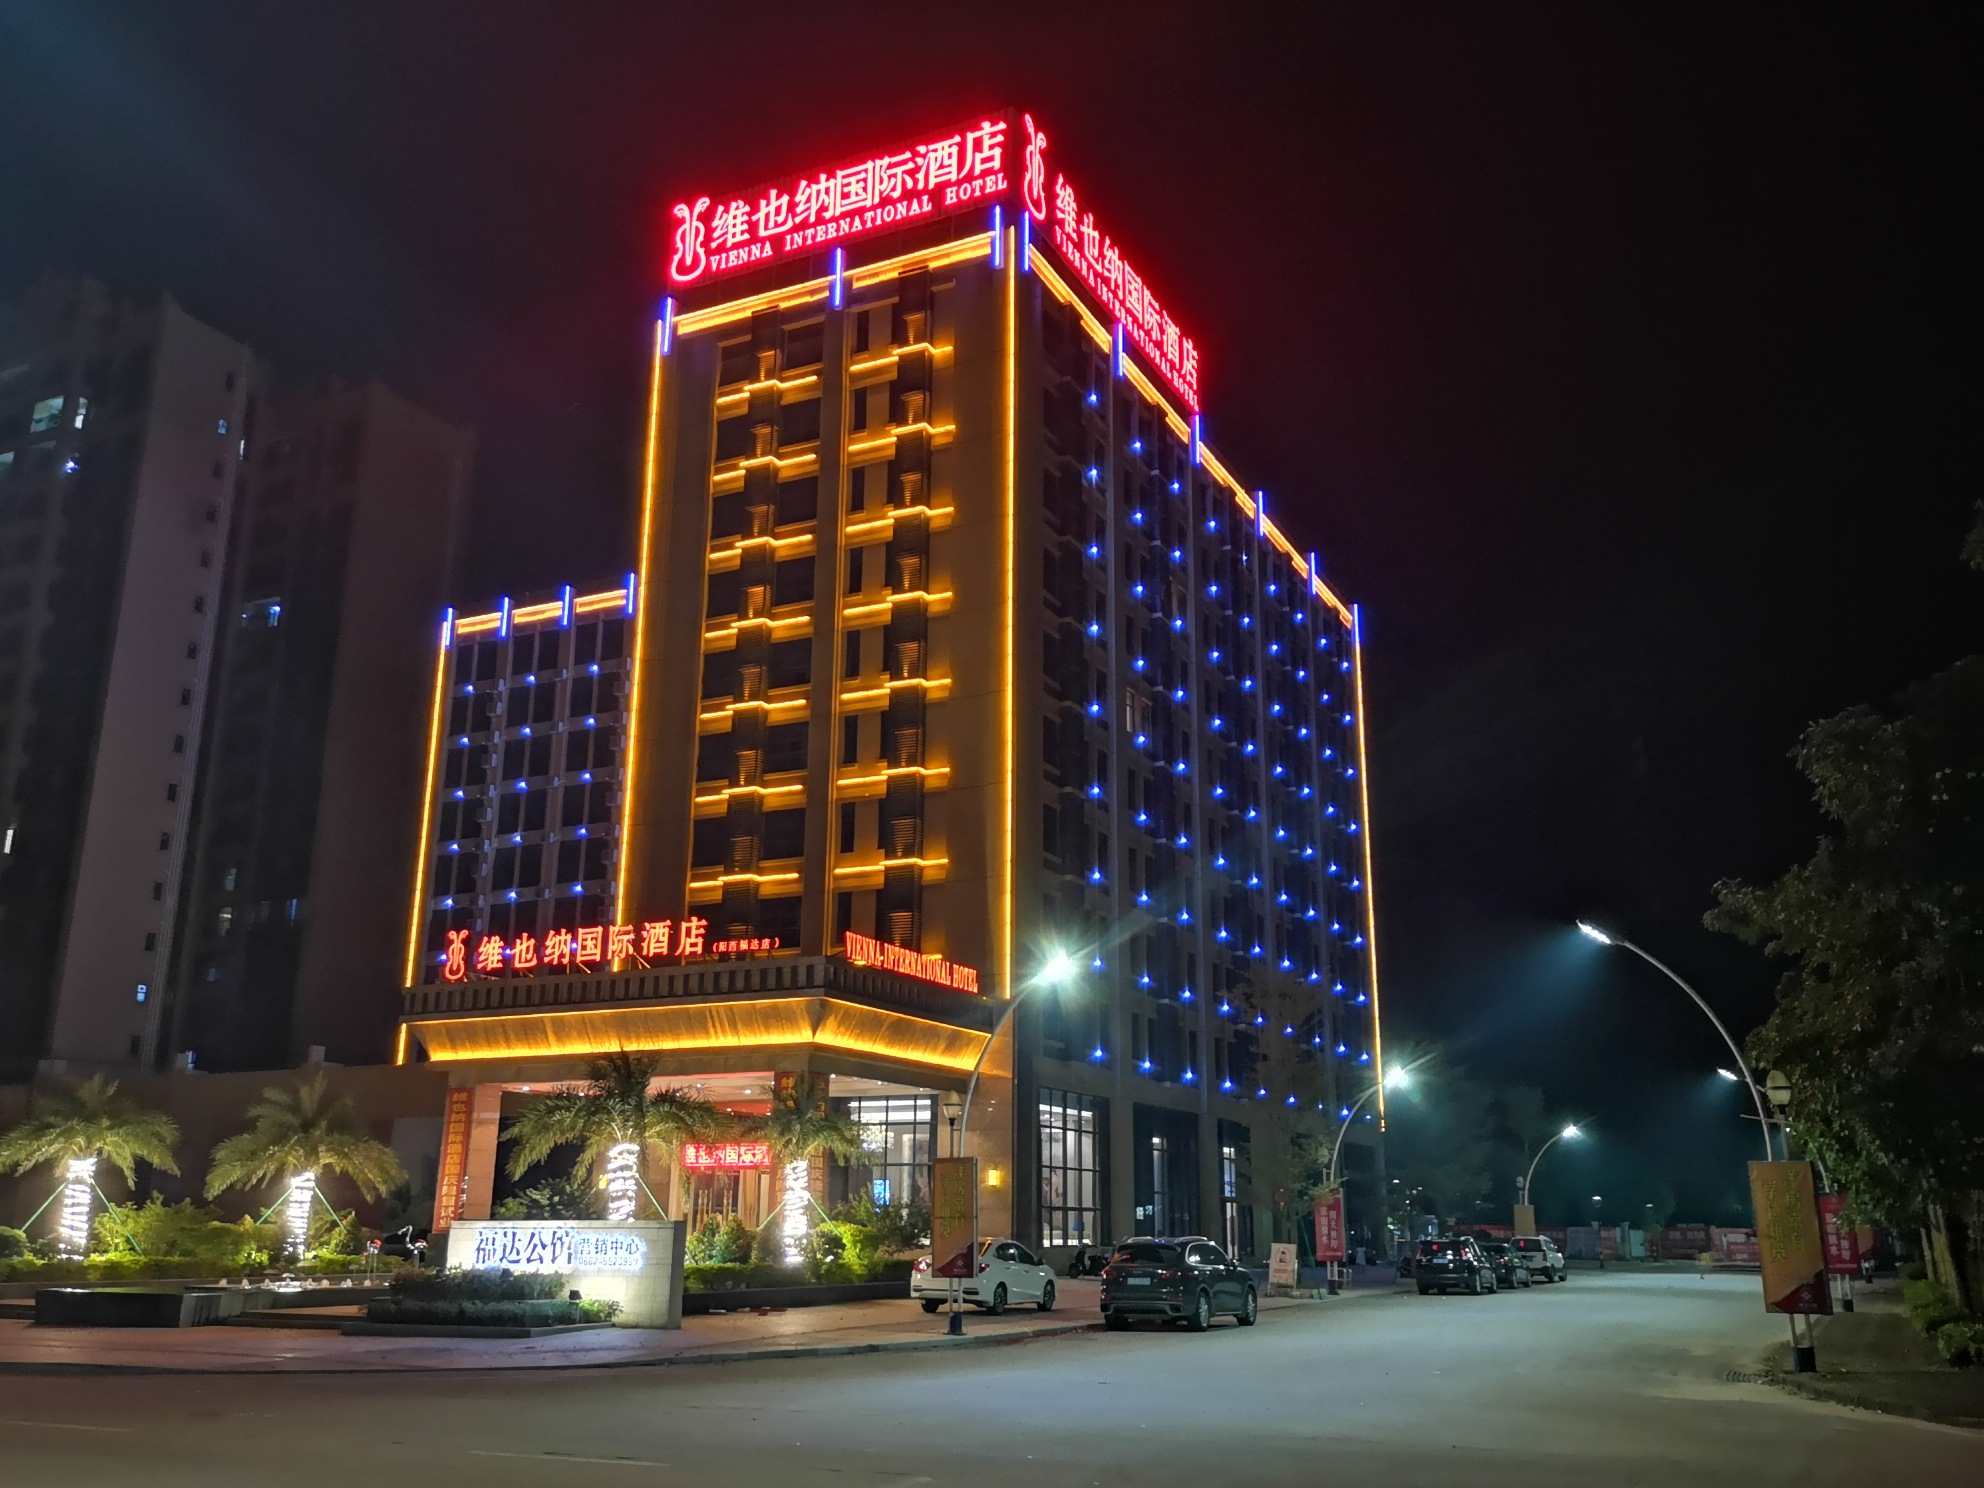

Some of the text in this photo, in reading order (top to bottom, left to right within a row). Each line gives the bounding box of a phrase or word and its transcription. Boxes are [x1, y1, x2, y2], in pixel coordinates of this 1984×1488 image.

[709, 120, 1007, 249] 维也纳国际酒店
[709, 172, 1008, 273] VIENNA INTERNATIONAL HOTEL
[1055, 172, 1199, 391] 维也纳国际酒店
[1055, 224, 1200, 413] VIENNA INTERNATIONAL HOTEL
[477, 915, 709, 972] 维也纳国际酒店
[846, 930, 978, 994] VIENNA INTERNATIONAL HOTEL
[475, 1230, 640, 1265] 福达公馆 营销中心
